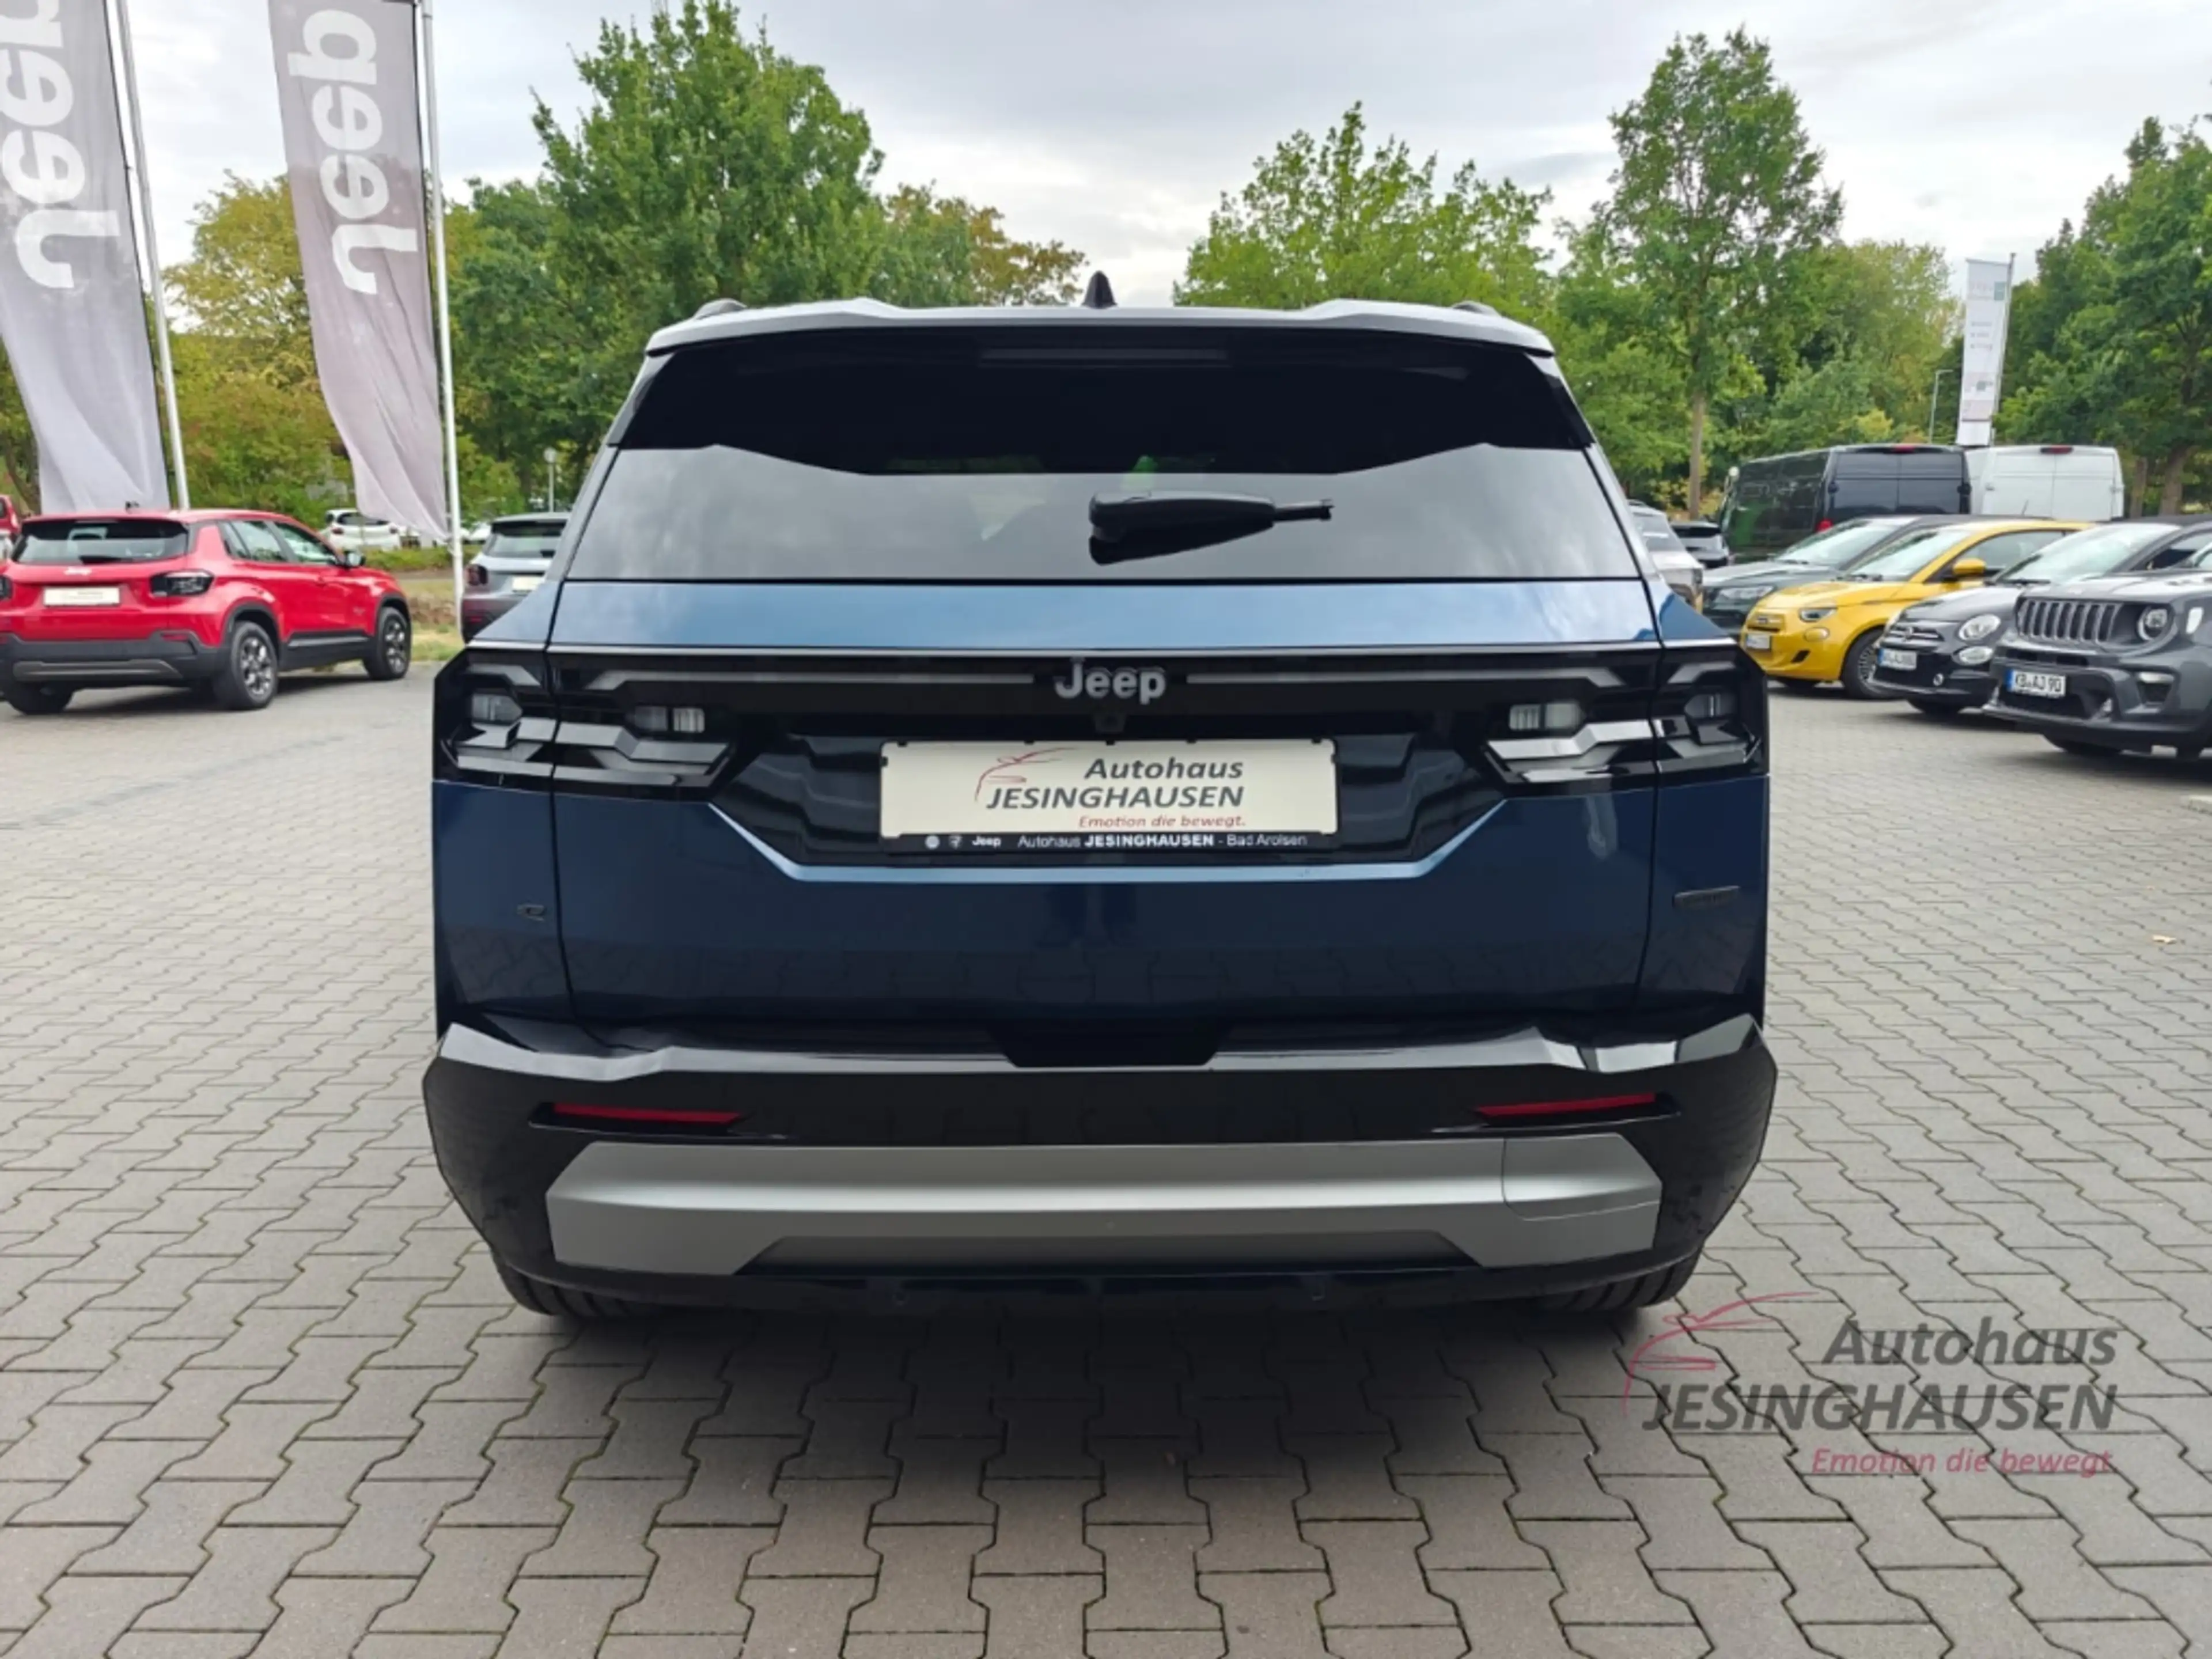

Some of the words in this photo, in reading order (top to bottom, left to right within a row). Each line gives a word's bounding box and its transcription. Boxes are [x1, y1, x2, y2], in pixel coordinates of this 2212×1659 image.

[1054, 658, 1166, 704] Jeep
[1084, 757, 1244, 779] Autohaus
[986, 786, 1244, 809] JESINGHAUSEN
[1079, 816, 1146, 828] Emotion
[1151, 815, 1176, 828] die
[1180, 815, 1247, 830] bewegt.
[972, 836, 1001, 848] Jeep
[1018, 835, 1081, 848] Autohaus
[1084, 835, 1214, 847] JESINGHAUSEN
[1226, 835, 1253, 846] Bad
[1256, 835, 1308, 846] Arolsen
